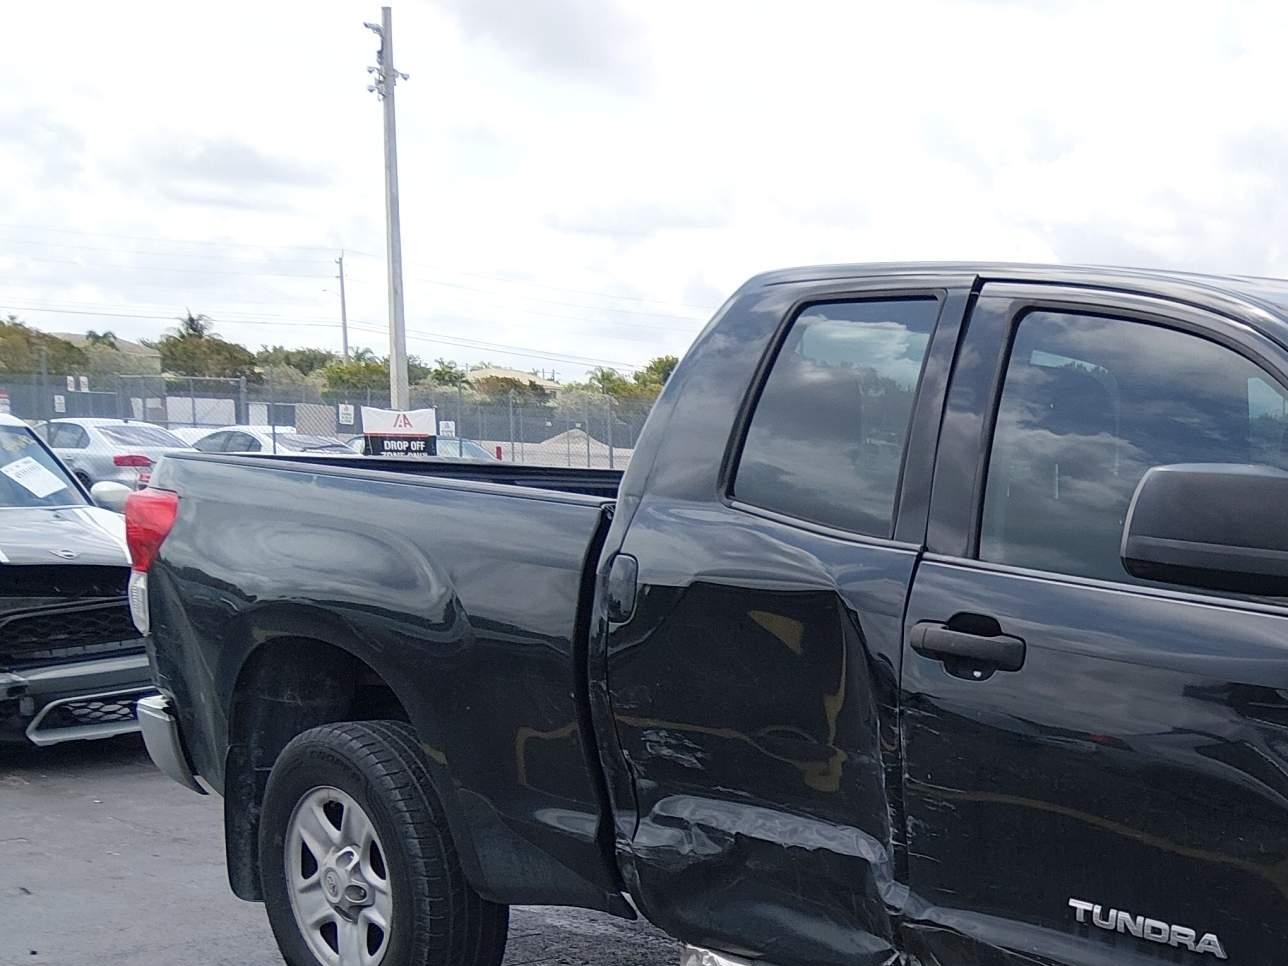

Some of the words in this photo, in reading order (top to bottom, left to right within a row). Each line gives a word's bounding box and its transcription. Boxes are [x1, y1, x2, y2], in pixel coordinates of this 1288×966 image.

[384, 440, 409, 451] DROP
[410, 440, 426, 451] OFF
[1068, 898, 1228, 959] TUNDRA
